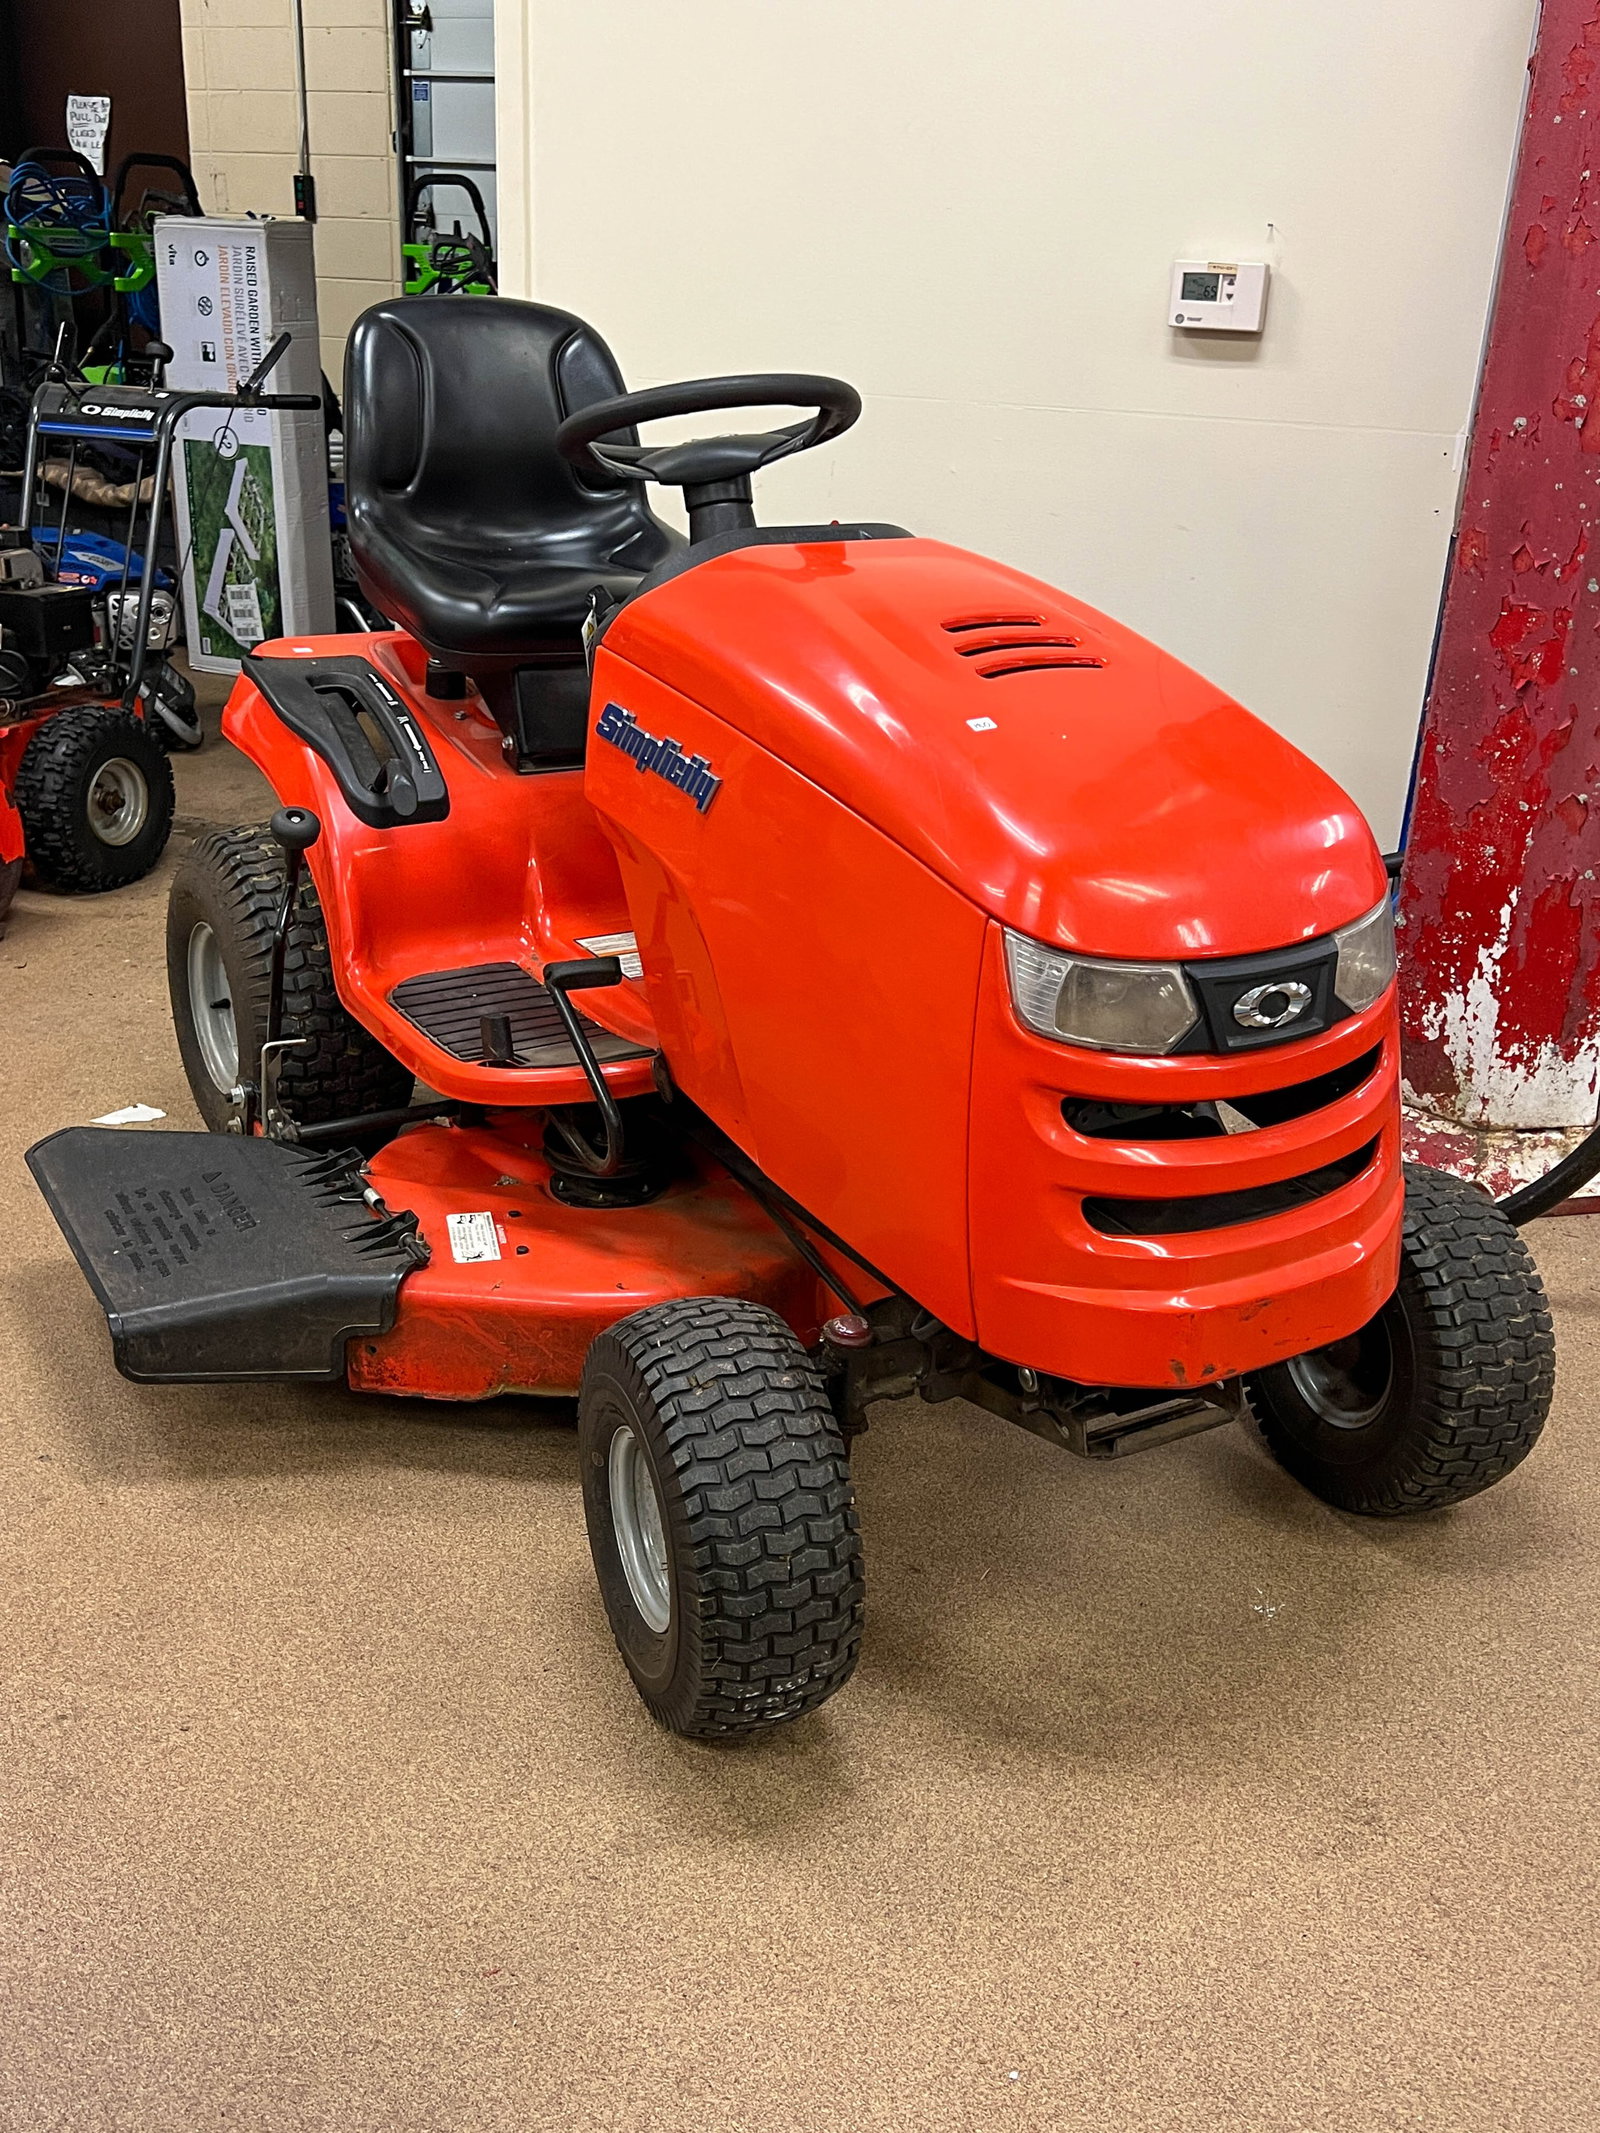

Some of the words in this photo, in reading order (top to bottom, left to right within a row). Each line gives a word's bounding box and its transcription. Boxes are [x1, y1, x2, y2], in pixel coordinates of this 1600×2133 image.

[232, 245, 244, 285] JARDIN
[245, 246, 258, 286] RAISED
[220, 287, 233, 335] ELEVADO
[247, 290, 260, 334] GARDEN
[224, 338, 235, 360] CON
[237, 345, 250, 372] AVEC
[250, 337, 262, 365] WITH
[101, 406, 155, 421] Simplicity
[596, 701, 723, 815] Simplicity
[210, 1182, 256, 1232] DANGER
